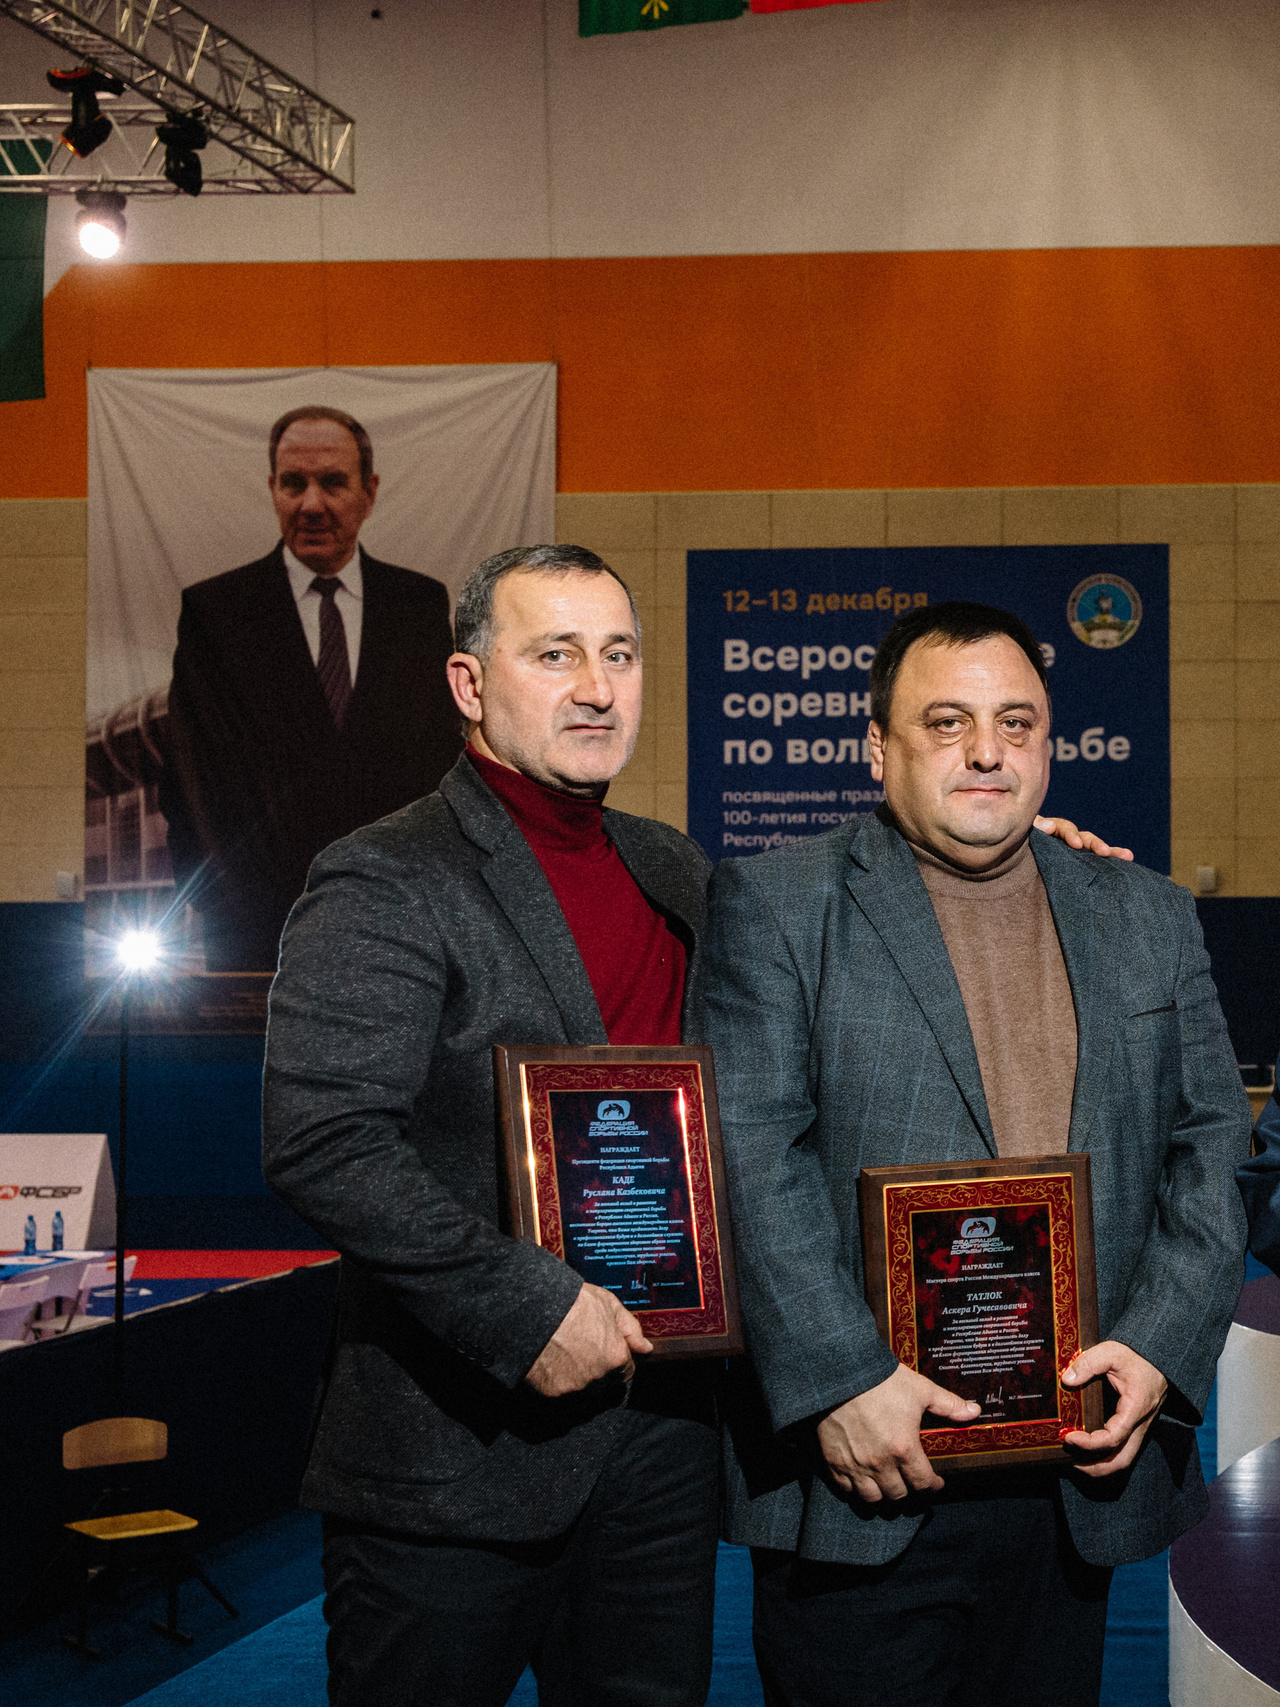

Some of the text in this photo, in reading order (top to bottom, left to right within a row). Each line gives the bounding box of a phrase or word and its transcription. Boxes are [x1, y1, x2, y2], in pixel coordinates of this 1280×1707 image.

[806, 586, 928, 615] декабря
[723, 692, 872, 727] соревн
[723, 739, 773, 765] по
[723, 810, 807, 826] 100-летия
[612, 1176, 635, 1185] КАДЕ
[952, 1241, 1003, 1250] СПОРТИВНОЙ
[953, 1237, 1000, 1245] ФЕДЕРАЦИЯ
[962, 1262, 1003, 1271] НАГРАЖДАЕТ
[967, 1292, 1002, 1301] ТАТЛОК
[942, 1306, 971, 1316] Аскера
